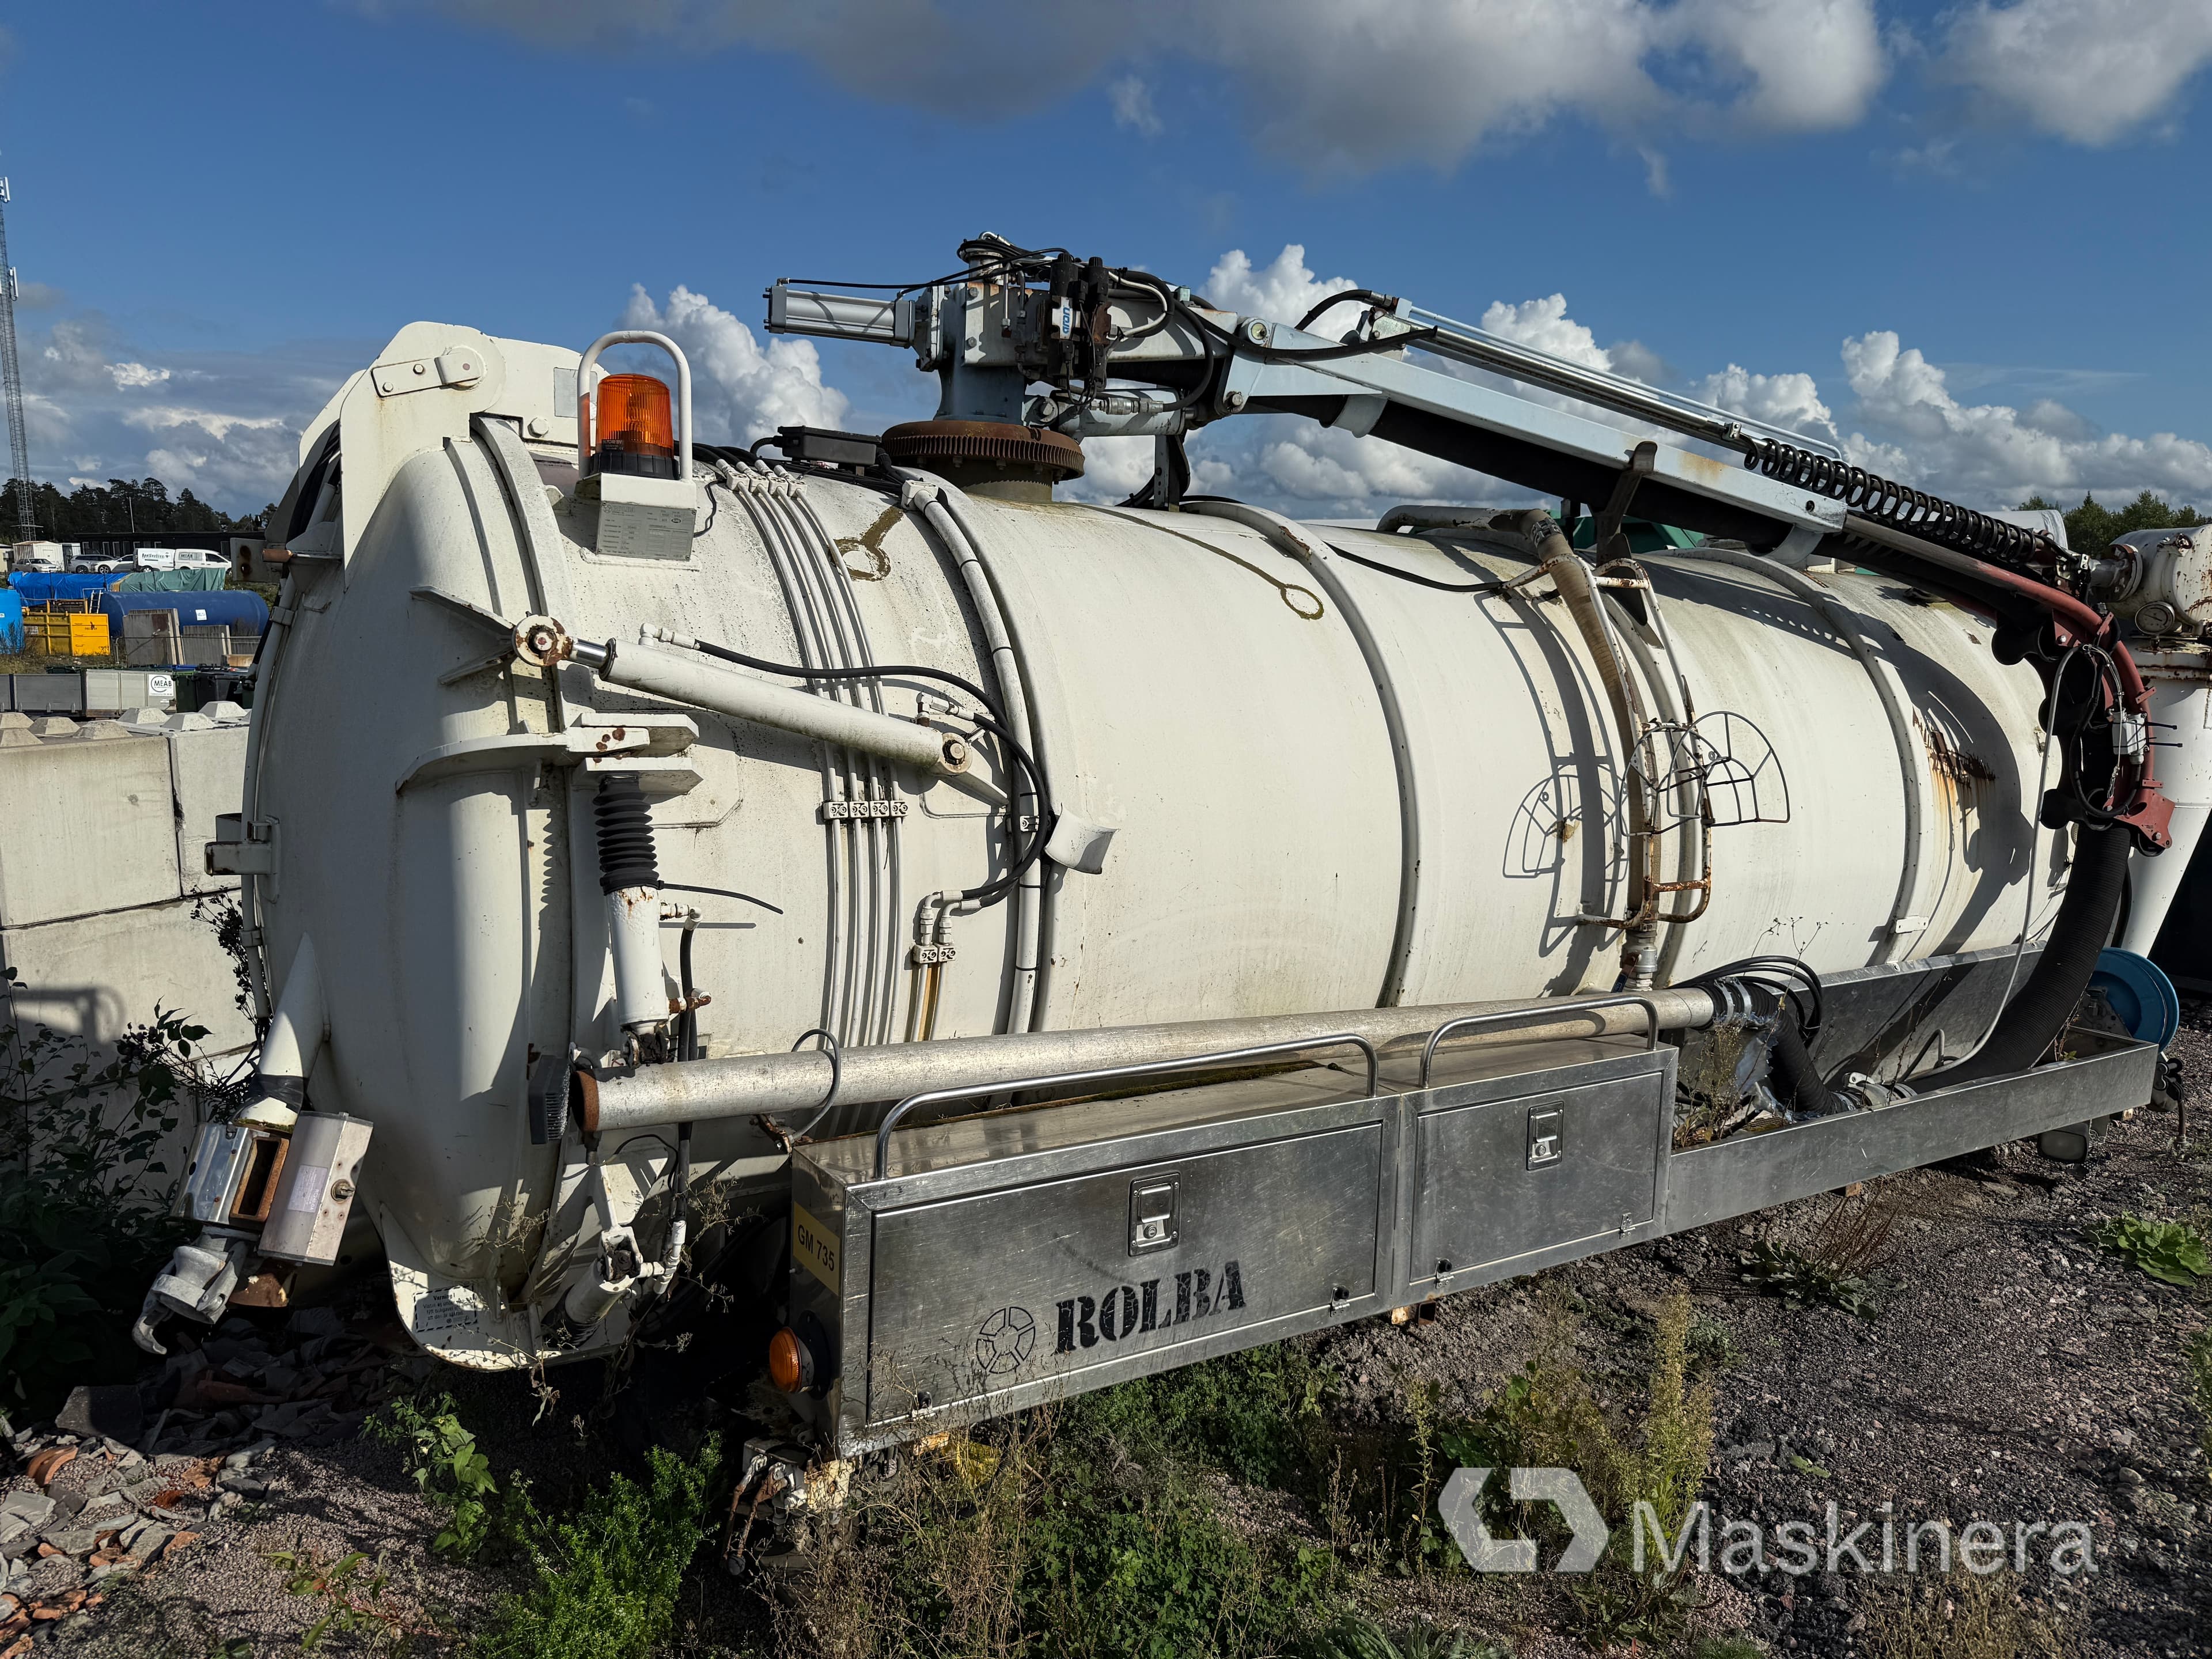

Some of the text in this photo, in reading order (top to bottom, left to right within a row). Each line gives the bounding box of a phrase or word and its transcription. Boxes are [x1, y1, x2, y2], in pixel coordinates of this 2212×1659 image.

[798, 1225, 834, 1271] GM 735
[1054, 1260, 1247, 1354] ROLBA
